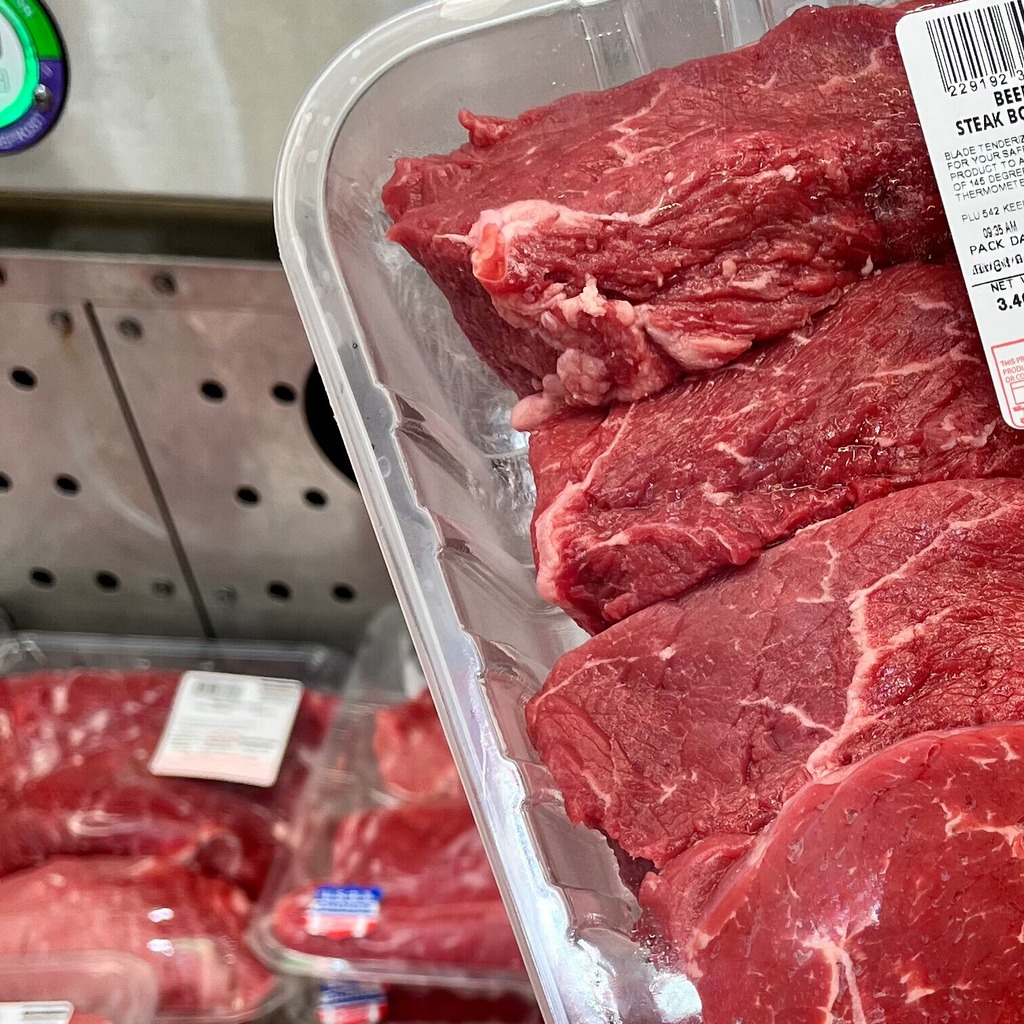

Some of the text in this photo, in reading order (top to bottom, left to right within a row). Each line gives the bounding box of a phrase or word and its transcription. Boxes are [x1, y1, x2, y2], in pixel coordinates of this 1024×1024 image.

[947, 74, 1008, 97] 229192
[956, 111, 1004, 136] STEAK
[944, 146, 976, 161] BLADE
[947, 159, 969, 170] FOR
[971, 151, 1001, 163] YOUR
[950, 163, 997, 181] PRODUCT
[1001, 159, 1016, 168] TO
[953, 181, 966, 191] OF
[970, 177, 985, 186] 145
[962, 212, 980, 222] PLU
[970, 239, 1005, 255] PACK
[991, 279, 1013, 292] NET
